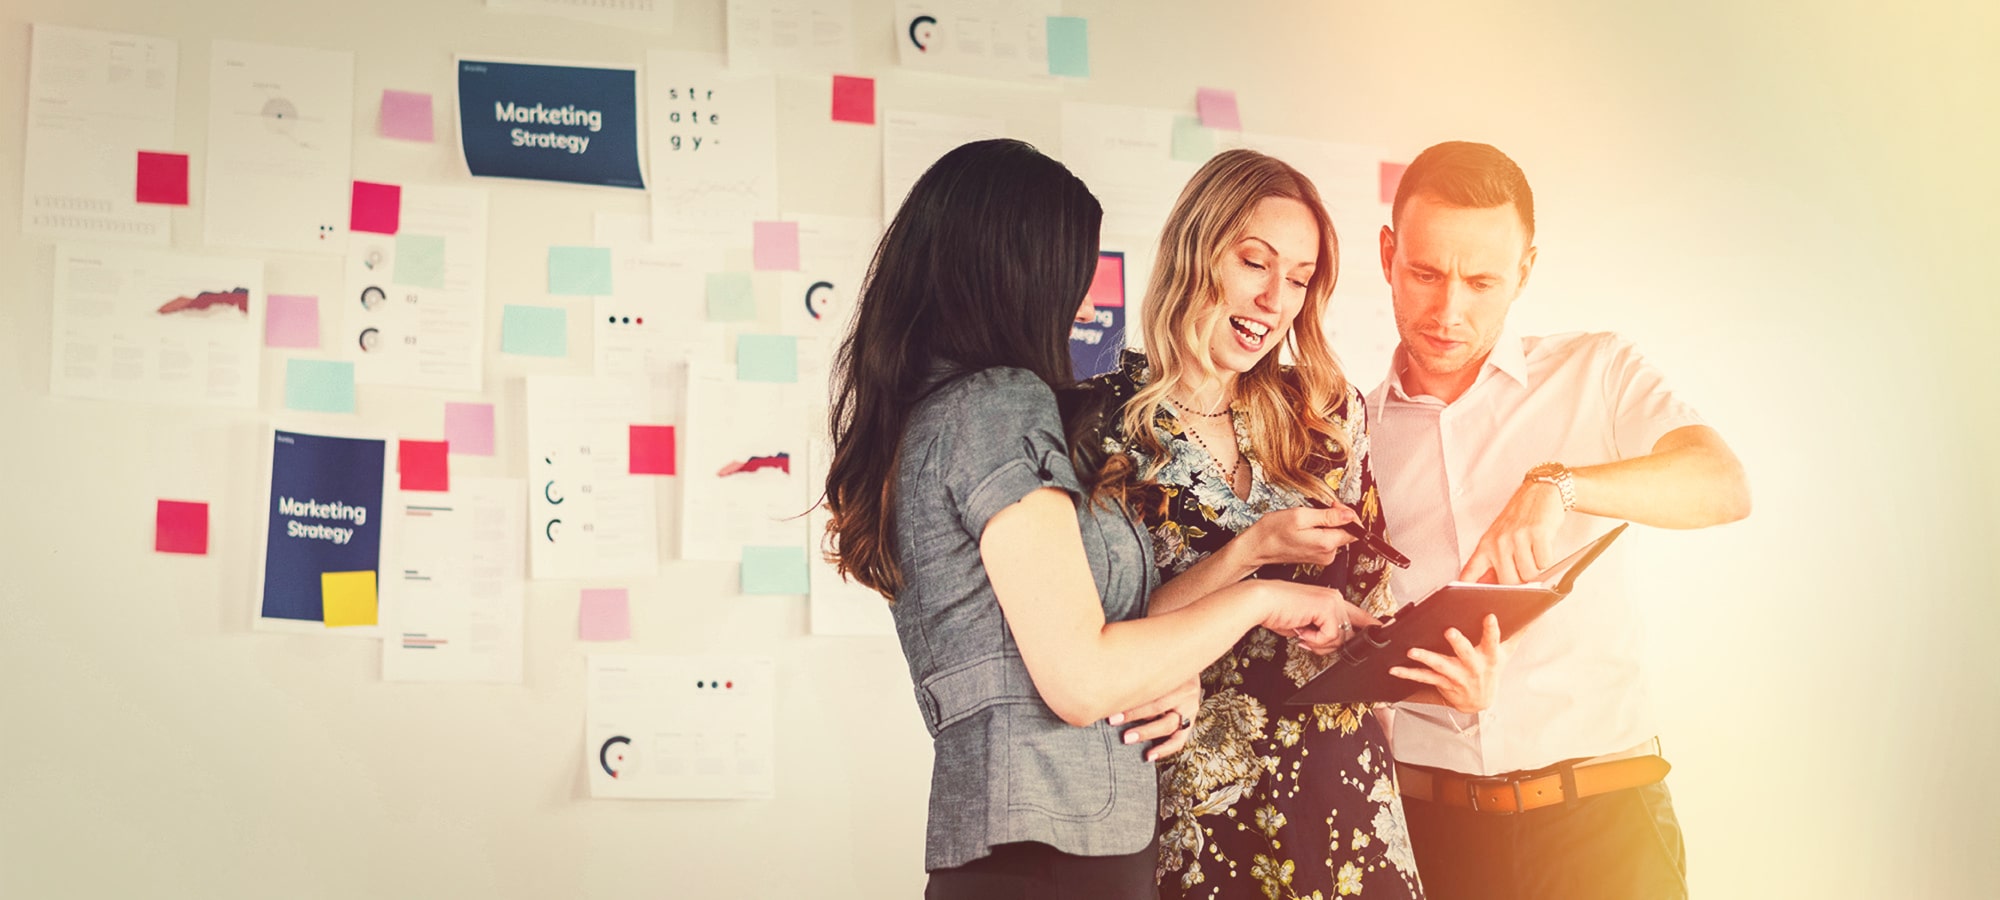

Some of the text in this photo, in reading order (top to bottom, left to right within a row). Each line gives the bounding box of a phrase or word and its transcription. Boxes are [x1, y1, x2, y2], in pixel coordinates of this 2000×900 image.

[495, 101, 602, 132] Marketing
[511, 128, 590, 154] Strategy
[279, 496, 367, 526] Marketing
[287, 520, 353, 545] Strategy
